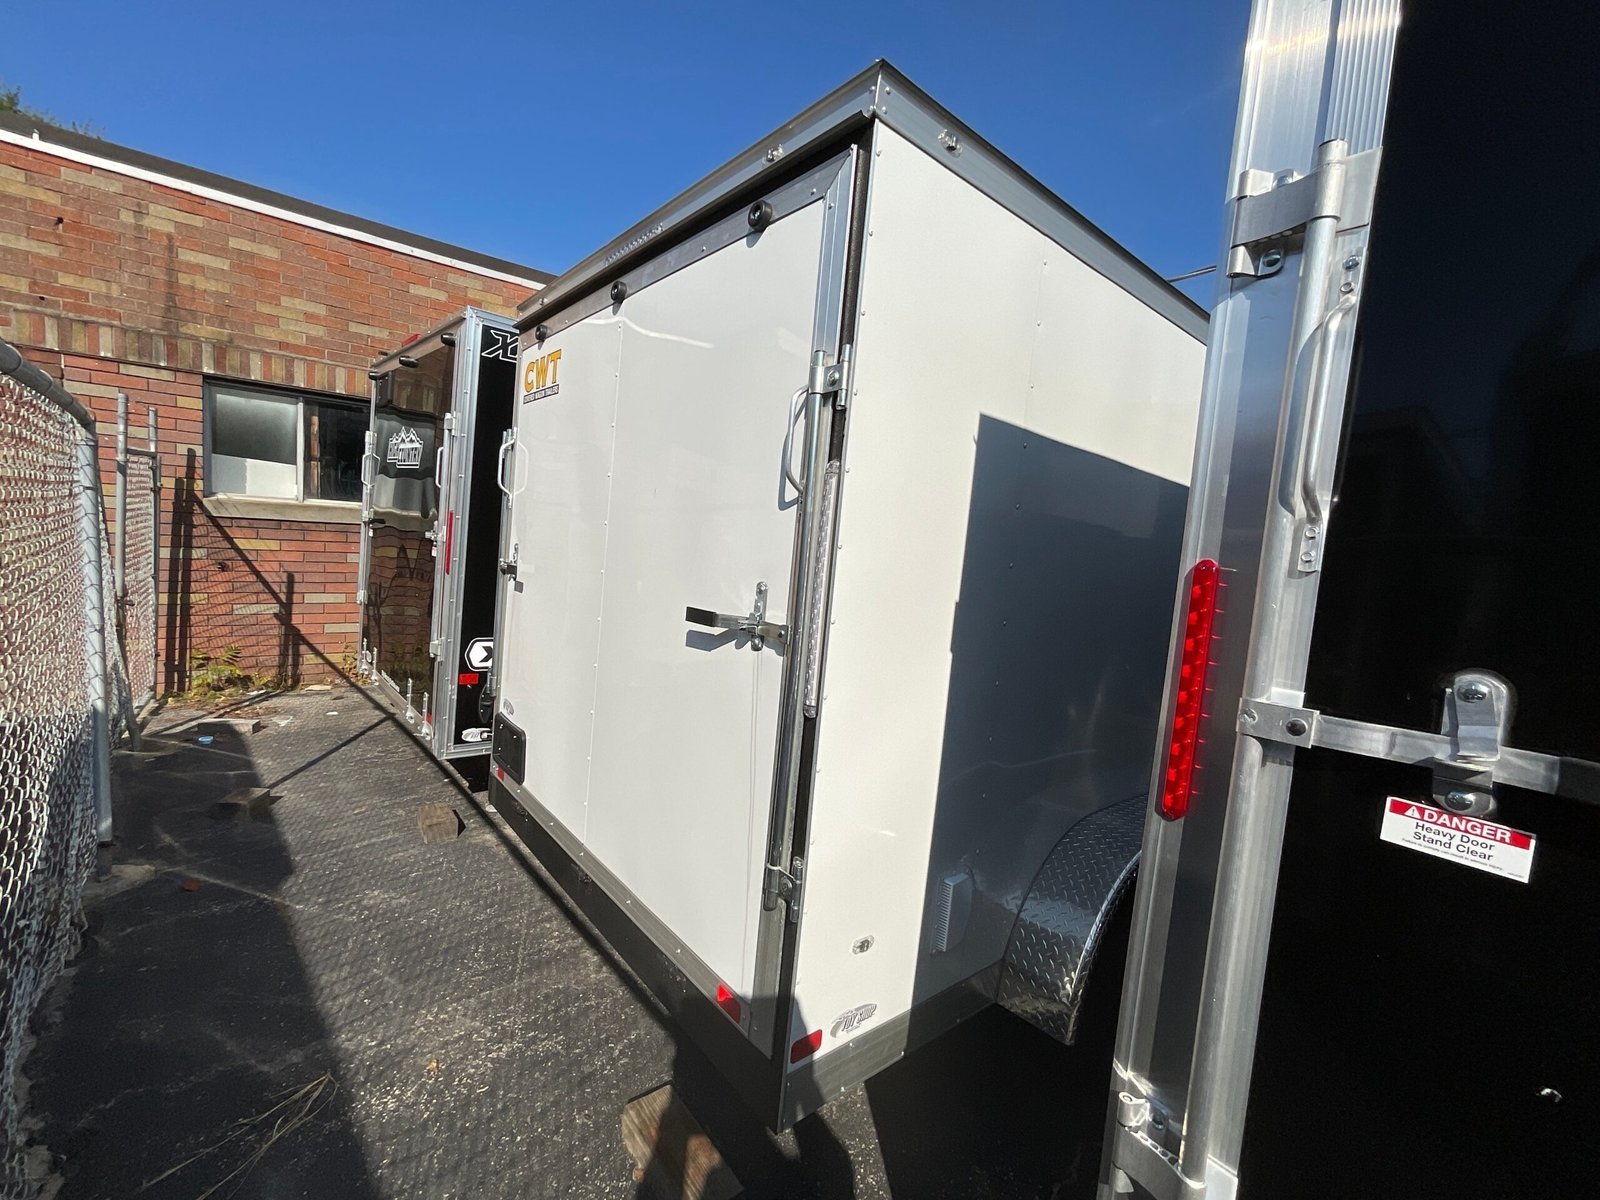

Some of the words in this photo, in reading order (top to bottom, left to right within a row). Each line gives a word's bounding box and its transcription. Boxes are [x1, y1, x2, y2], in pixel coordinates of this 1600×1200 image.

[524, 349, 562, 393] CWT
[1415, 822, 1456, 841] Heavy
[1460, 834, 1495, 851] Door
[1423, 809, 1512, 843] DANGER
[1413, 832, 1452, 849] Stand
[1456, 844, 1493, 861] Clear
